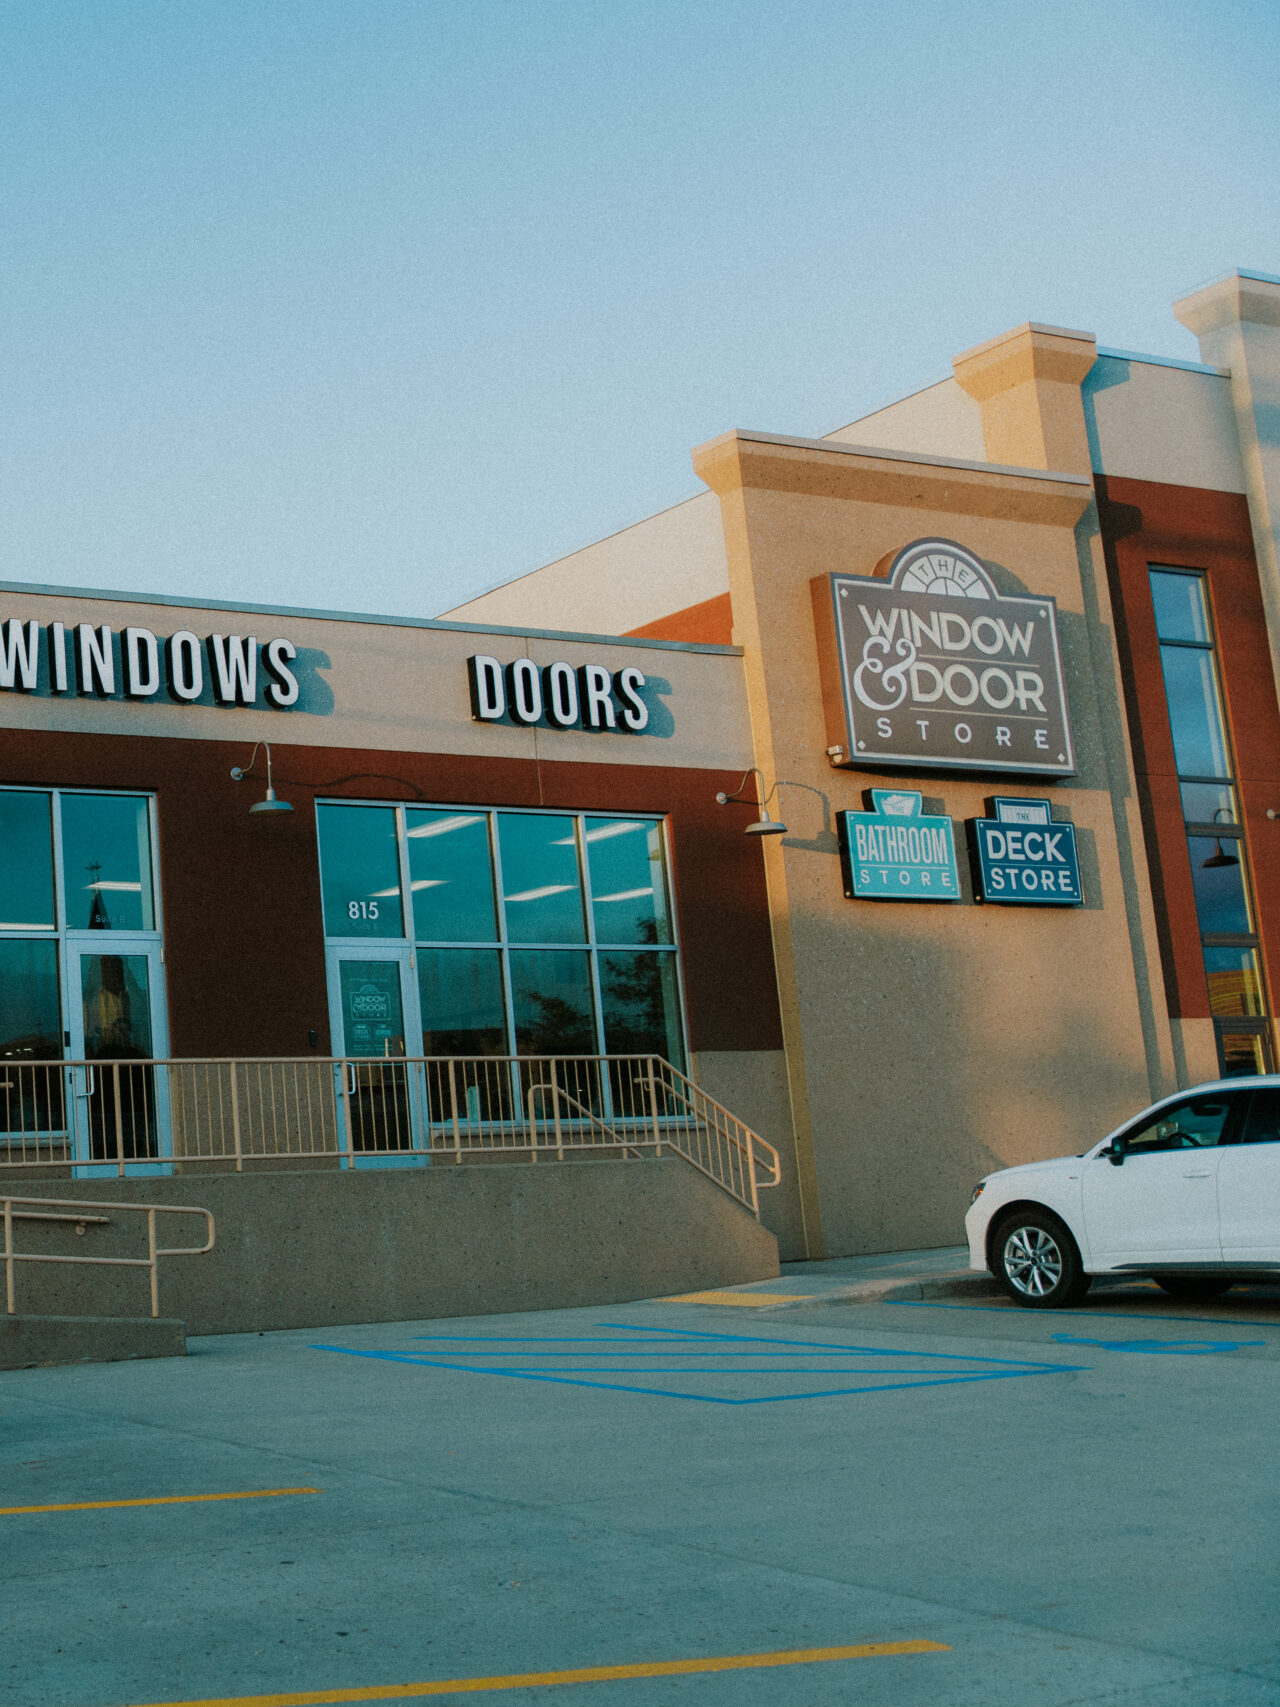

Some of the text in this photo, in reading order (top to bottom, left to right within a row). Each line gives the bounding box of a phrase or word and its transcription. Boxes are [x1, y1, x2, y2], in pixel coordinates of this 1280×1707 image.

[918, 559, 974, 583] THE
[857, 604, 1035, 657] WINDOW
[466, 654, 649, 732] DOORS
[909, 661, 1047, 712] DOOR
[876, 717, 1050, 749] STORE
[892, 805, 905, 814] THE
[1016, 812, 1031, 821] THE
[855, 823, 950, 865] BATHROOM
[986, 829, 1066, 862] DECK
[860, 869, 952, 887] STORE
[990, 867, 1074, 892] STORE
[348, 901, 379, 920] 815
[354, 995, 386, 1003] WINDOW
